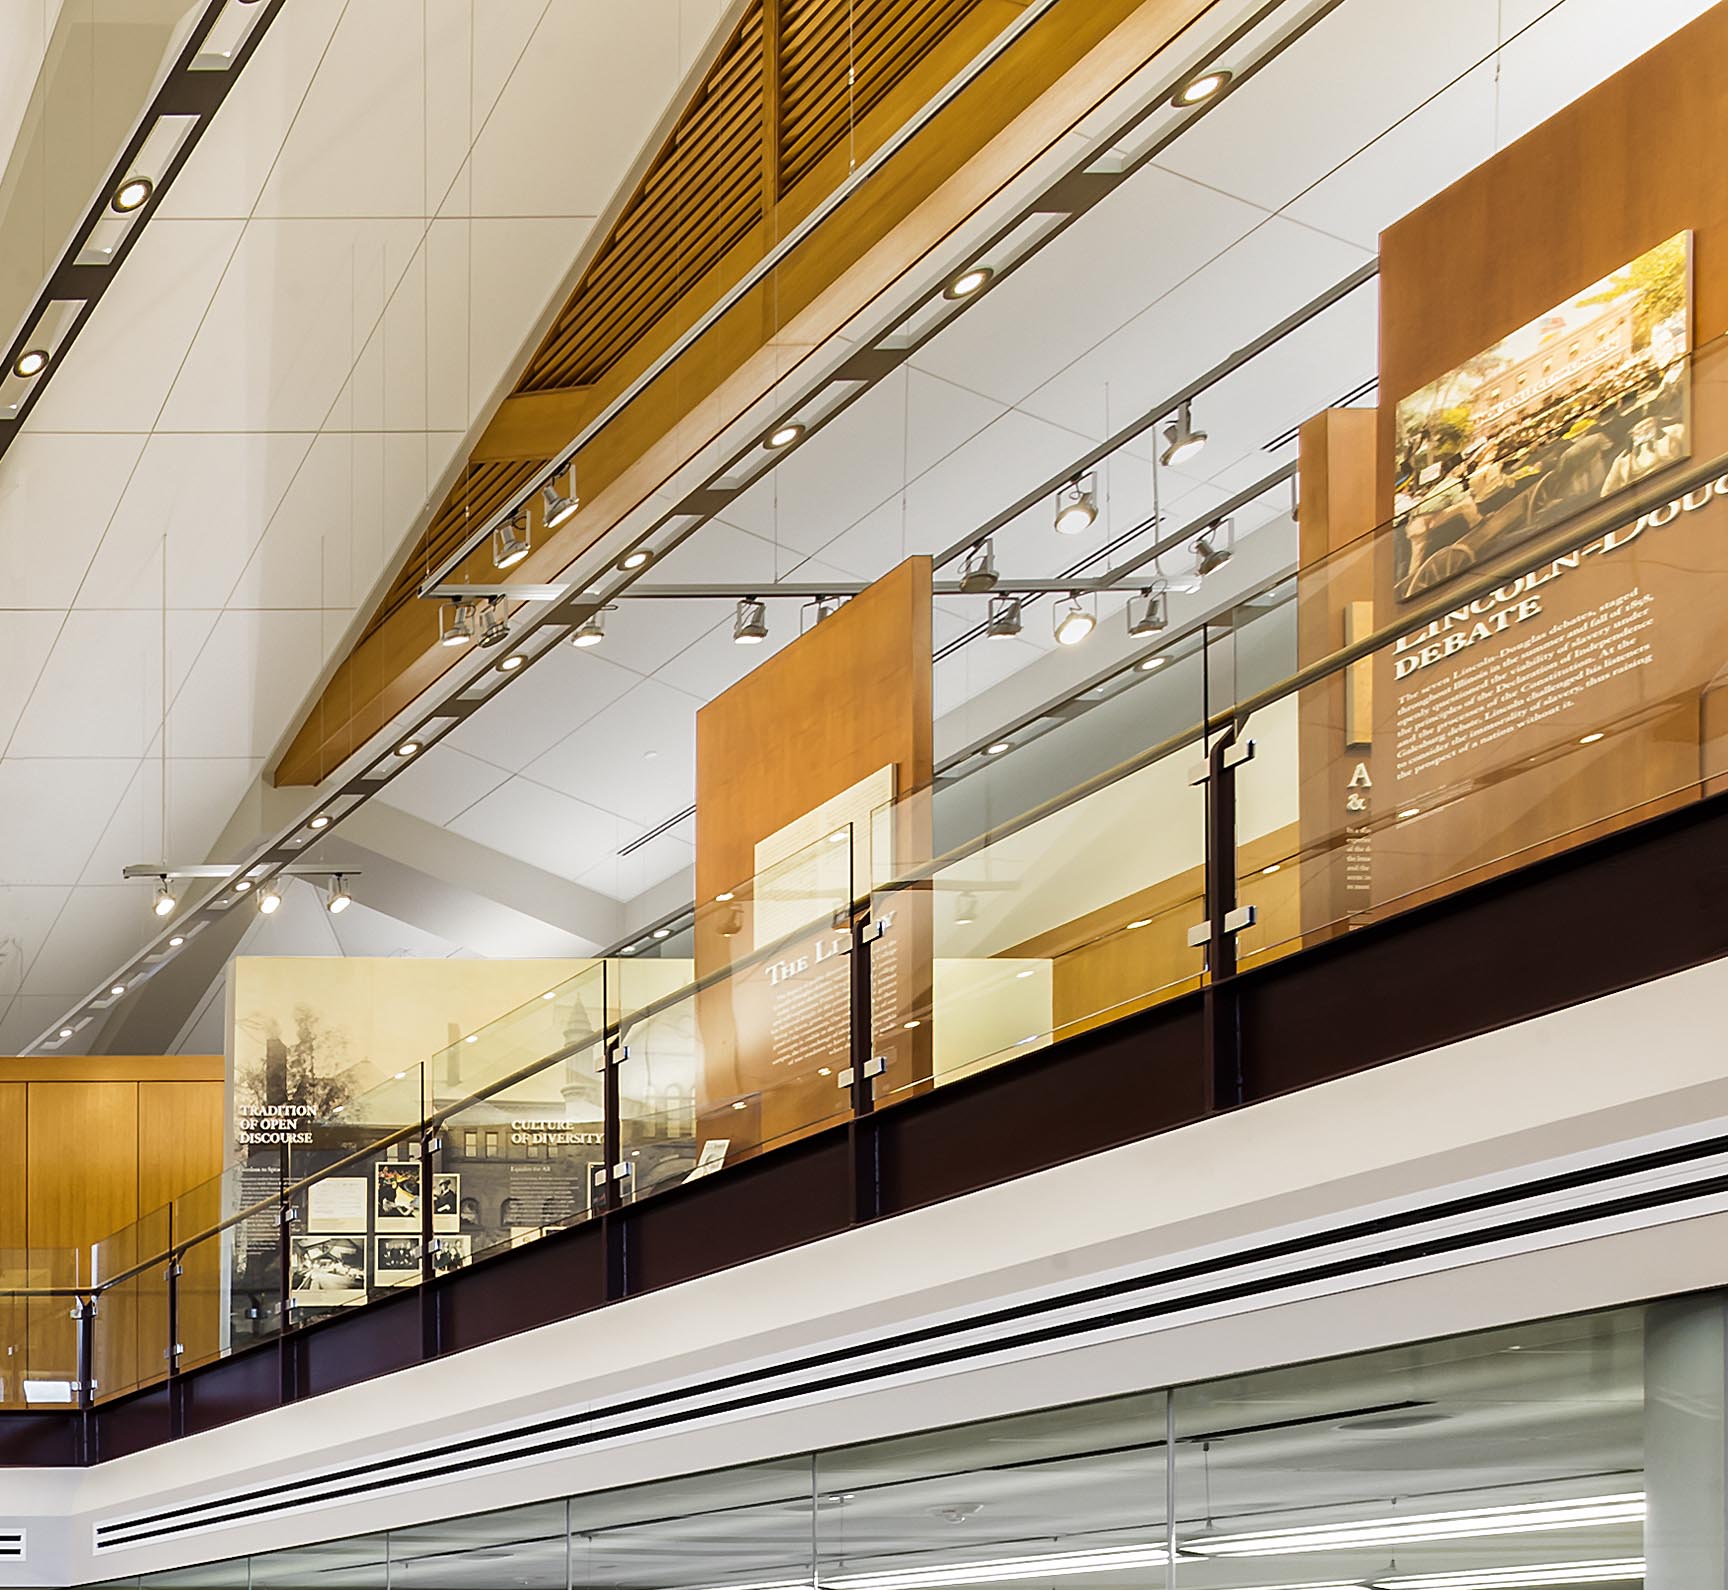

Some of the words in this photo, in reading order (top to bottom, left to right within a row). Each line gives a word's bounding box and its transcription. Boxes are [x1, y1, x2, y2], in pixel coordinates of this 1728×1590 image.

[1393, 594, 1543, 680] DEBATE
[1397, 687, 1451, 716] throughout
[1453, 671, 1488, 690] Illinois
[1490, 665, 1501, 673] in
[1502, 656, 1519, 667] the
[1521, 635, 1565, 659] summer
[1567, 622, 1588, 638] and
[1590, 613, 1608, 628] fall
[1609, 606, 1622, 618] of
[1400, 691, 1419, 704] The
[1421, 677, 1450, 694] seven
[1453, 632, 1547, 680] Lincoln-Douglas
[1548, 611, 1597, 635] debates,
[1599, 587, 1638, 612] staged
[1397, 708, 1430, 726] openly
[1432, 679, 1488, 711] questioned
[1490, 673, 1507, 684] the
[1510, 651, 1554, 675] viability
[1556, 641, 1569, 654] of
[1571, 626, 1611, 648] slavery
[1613, 608, 1649, 629] under
[1397, 727, 1413, 737] the
[1414, 704, 1463, 732] principles
[1464, 695, 1475, 707] of
[1477, 690, 1494, 701] the
[1496, 662, 1558, 693] Declaration
[1560, 652, 1572, 664] of
[1574, 618, 1653, 658] Independence
[1397, 734, 1416, 748] and
[1418, 728, 1434, 738] the
[1437, 706, 1485, 733] processes
[1486, 696, 1498, 708] of
[1501, 690, 1518, 702] the
[1520, 658, 1596, 692] Constitution.
[1599, 647, 1614, 659] At
[1617, 638, 1636, 650] the
[765, 956, 809, 986] THE
[239, 1104, 317, 1117] TRADITION
[239, 1132, 313, 1144] DISCOURSE
[240, 1118, 259, 1130] OF
[260, 1118, 297, 1130] OPEN
[511, 1120, 574, 1131] CULTURE
[511, 1133, 529, 1144] OF
[532, 1133, 605, 1145] DIVERSITY
